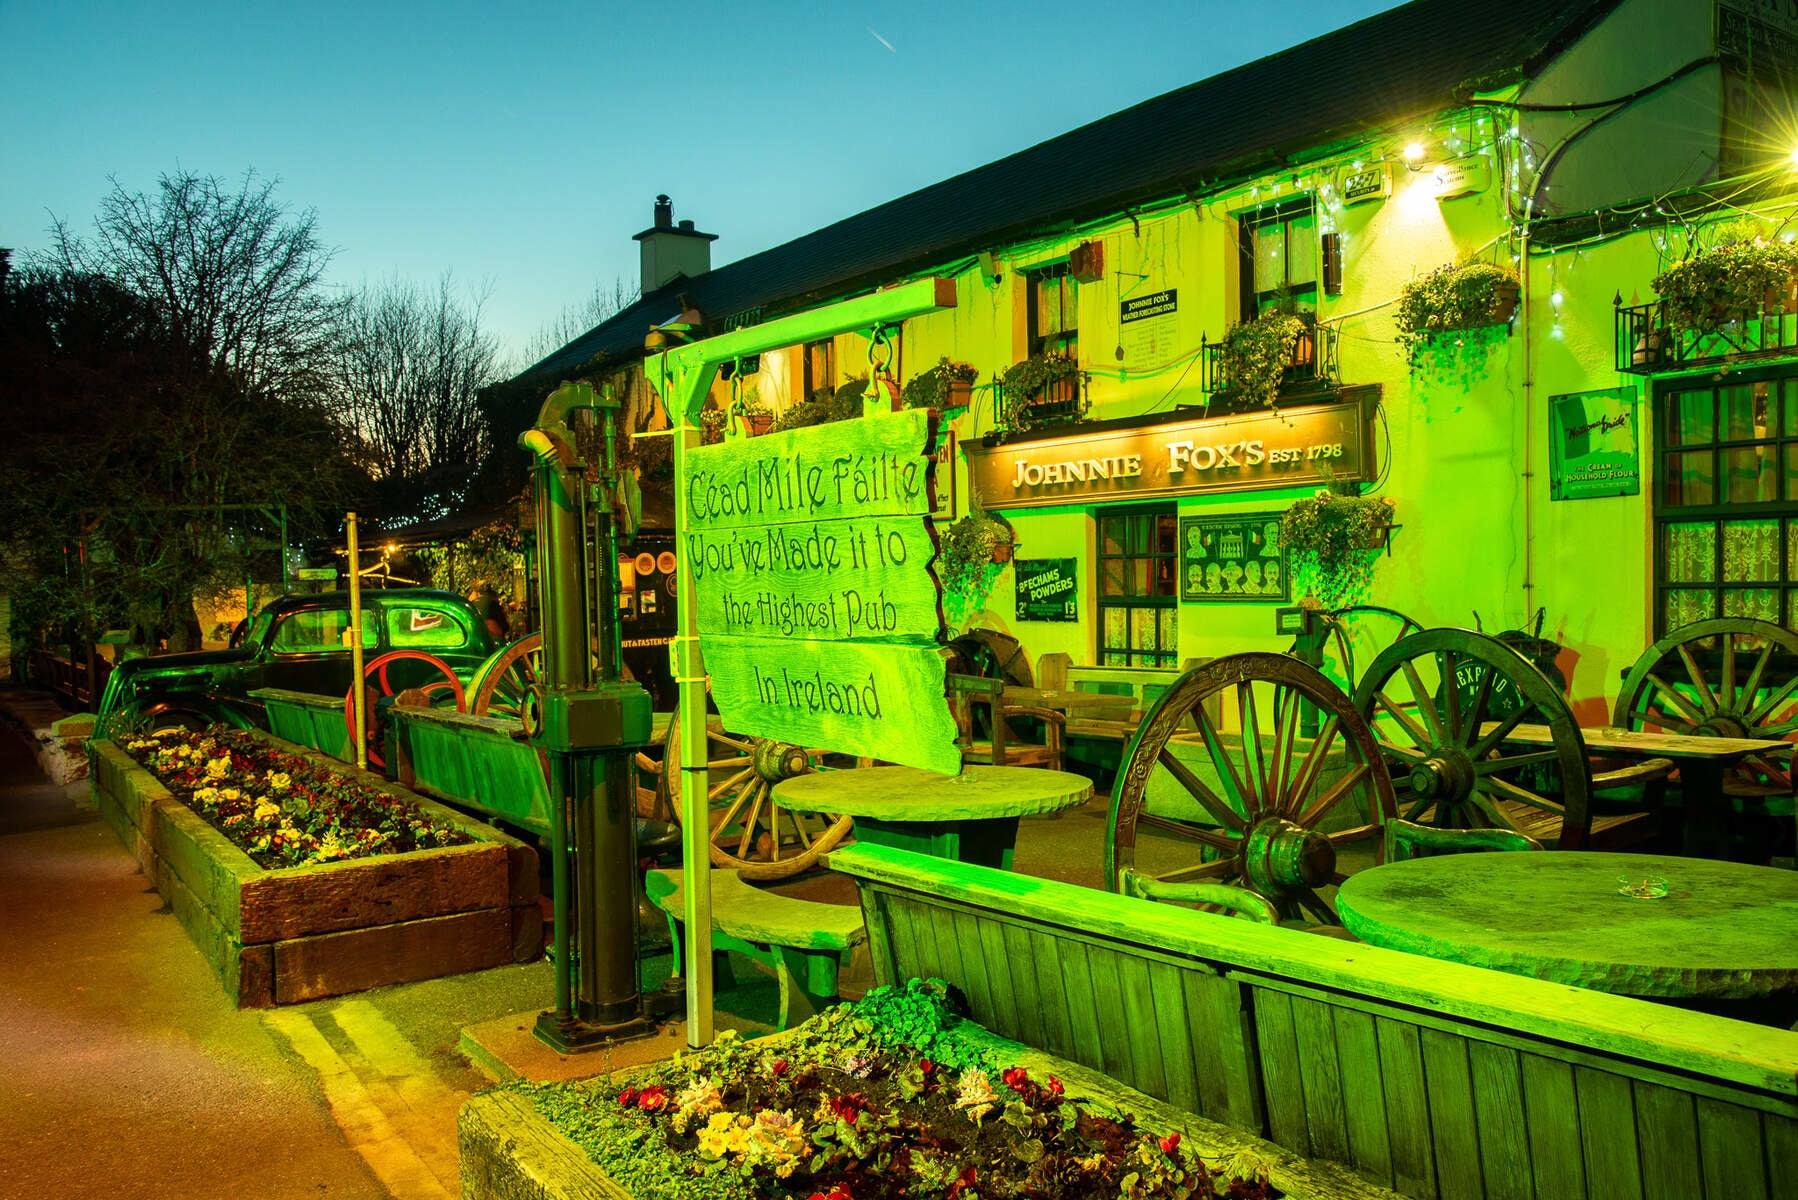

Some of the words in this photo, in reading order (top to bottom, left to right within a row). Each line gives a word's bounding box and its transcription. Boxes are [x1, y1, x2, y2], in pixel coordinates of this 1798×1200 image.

[1128, 297, 1152, 311] JOHNNIE
[1153, 292, 1169, 305] FOX'S
[1013, 453, 1142, 488] JOHNNIE
[1166, 440, 1264, 473] FOX'S
[1268, 448, 1302, 464] EST
[1307, 443, 1343, 461] 1798
[1566, 472, 1607, 483] HOUSEHOLD
[1610, 470, 1634, 480] FLOUR
[1588, 463, 1612, 472] CREAM
[690, 467, 752, 523] Céad
[833, 451, 920, 505] Fáilte
[689, 530, 764, 581] You've
[767, 524, 841, 574] Made
[849, 526, 866, 569] it
[875, 523, 907, 568] to
[1030, 577, 1073, 601] POWDERS
[723, 592, 753, 626] the
[757, 592, 838, 636] Highest
[843, 590, 898, 637] Pub
[637, 637, 663, 647] FASTEN
[754, 665, 779, 705] In
[781, 666, 883, 720] Ireland
